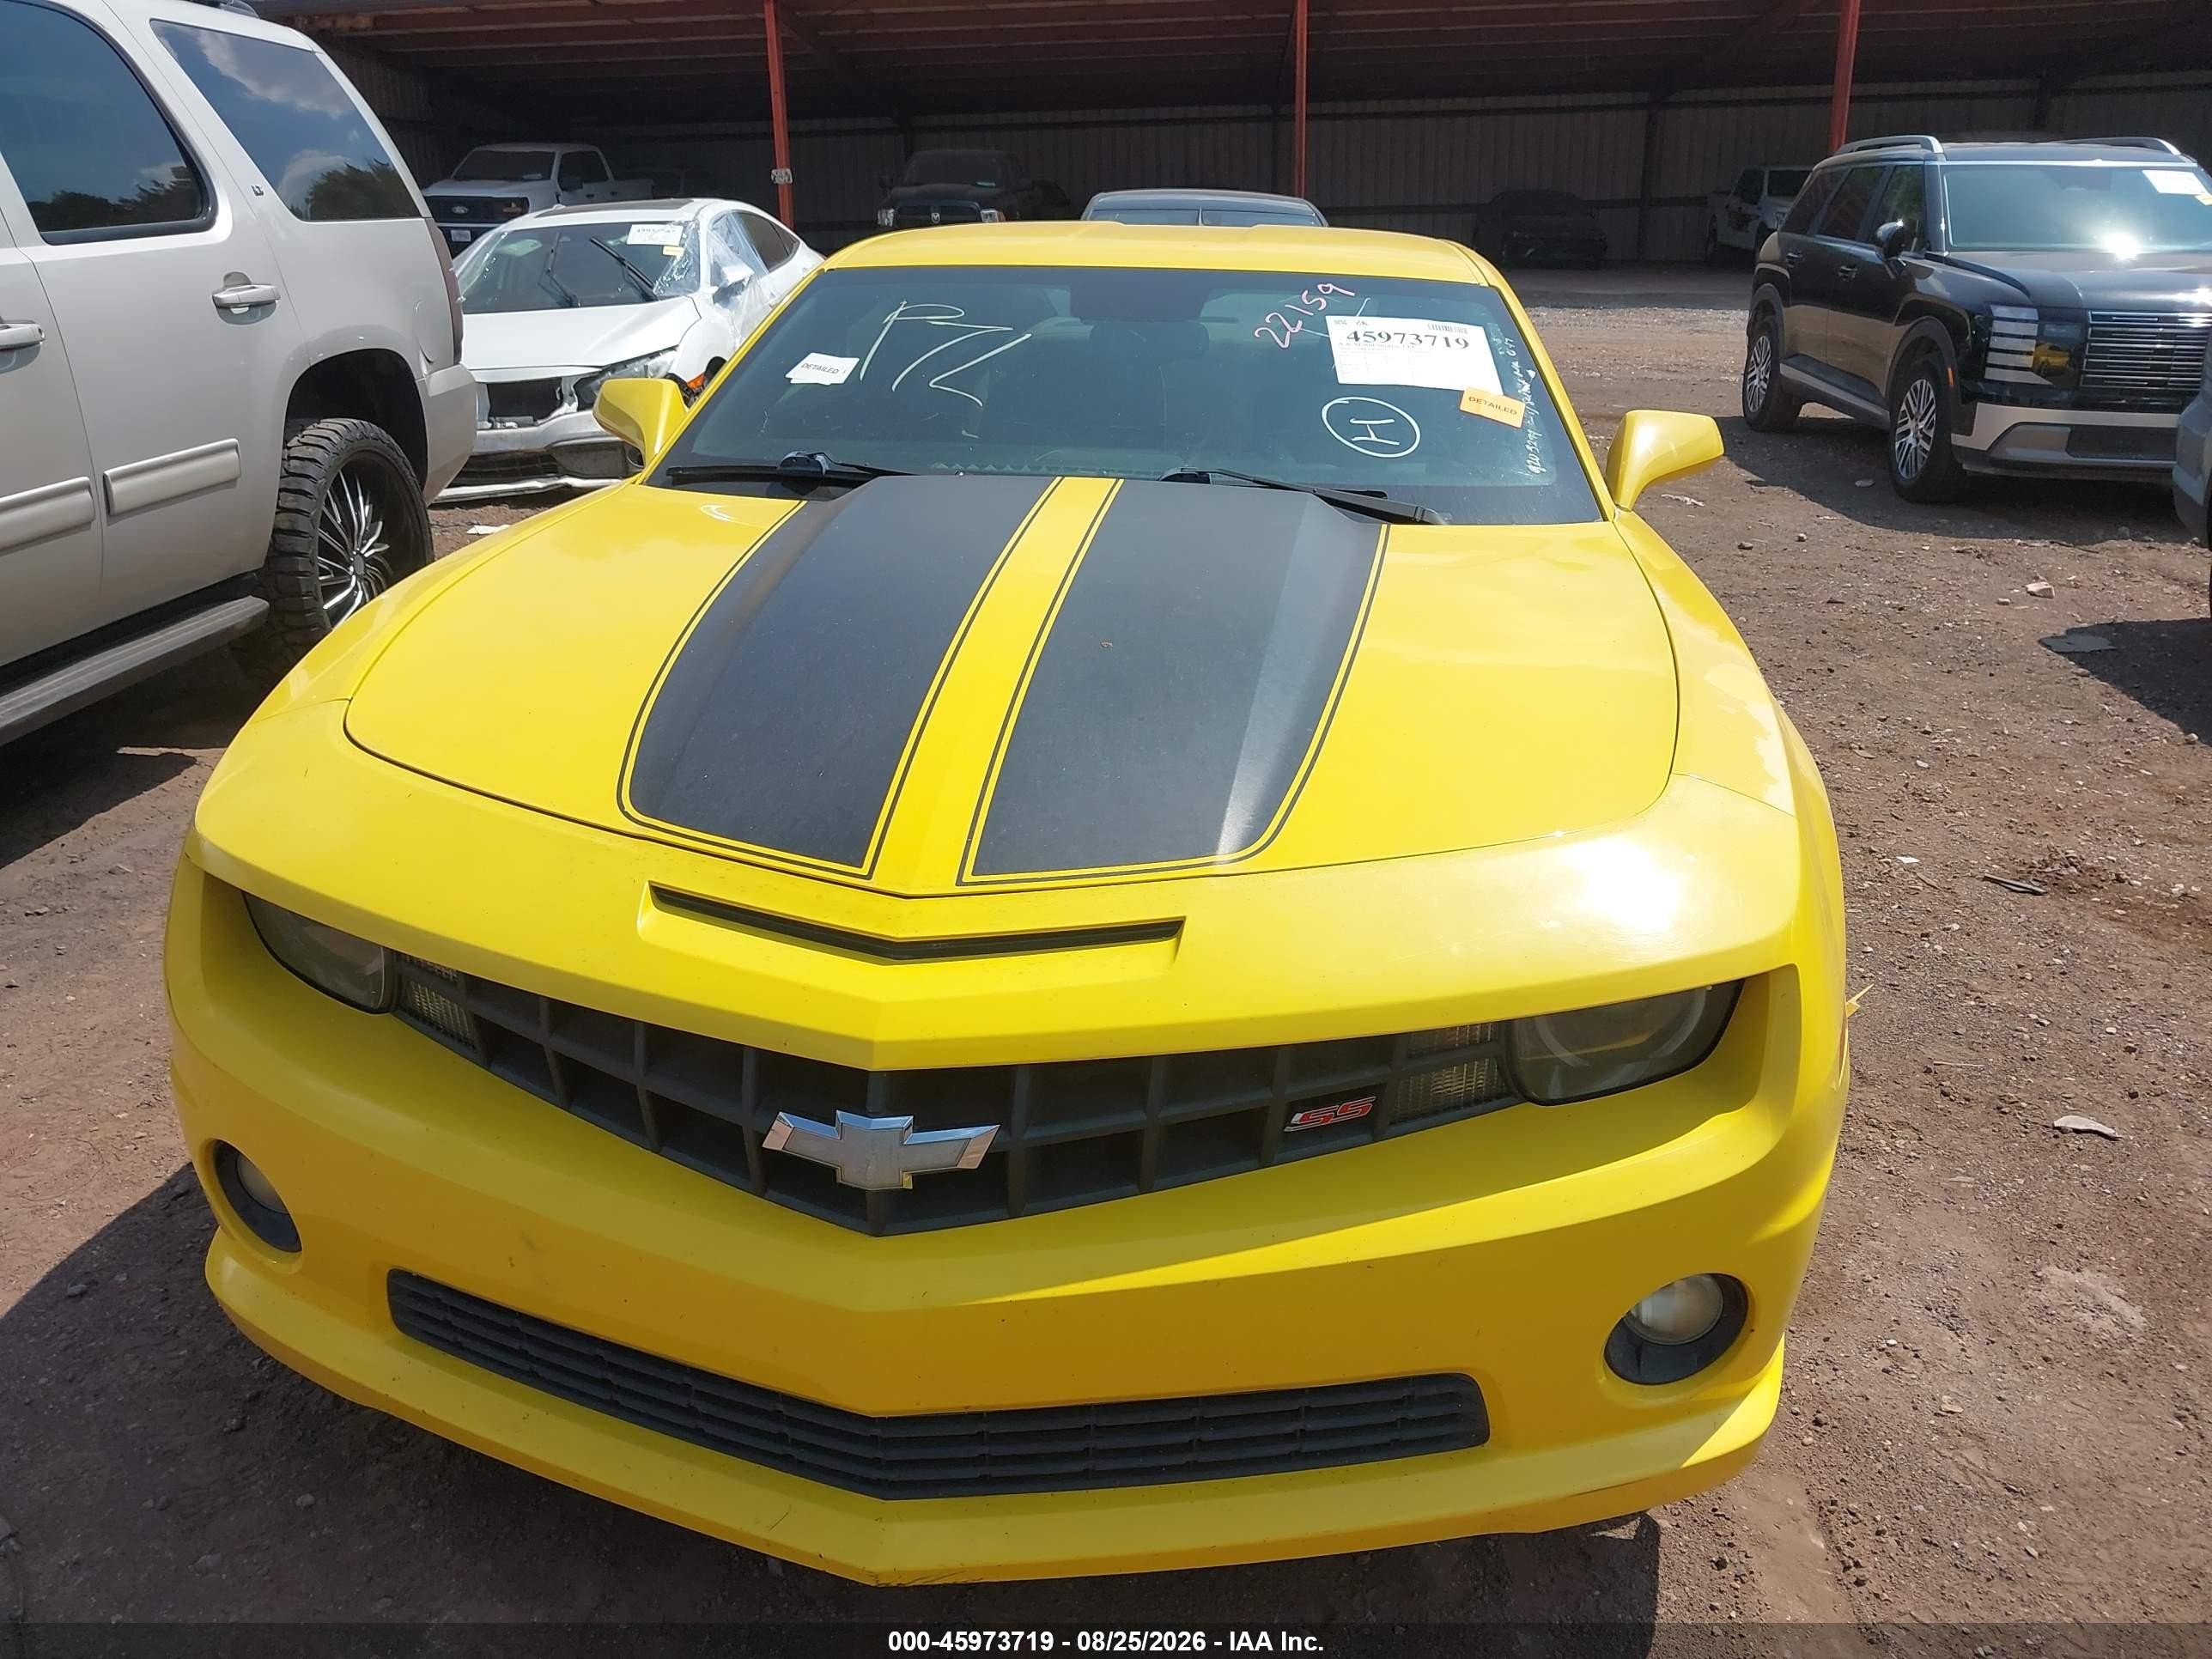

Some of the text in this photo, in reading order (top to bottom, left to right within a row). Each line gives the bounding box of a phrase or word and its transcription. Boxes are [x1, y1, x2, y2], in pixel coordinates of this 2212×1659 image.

[1346, 331, 1469, 349] 45973719
[801, 362, 839, 374] DETAILED
[1468, 396, 1517, 415] DETAILED
[1284, 1096, 1376, 1132] SS
